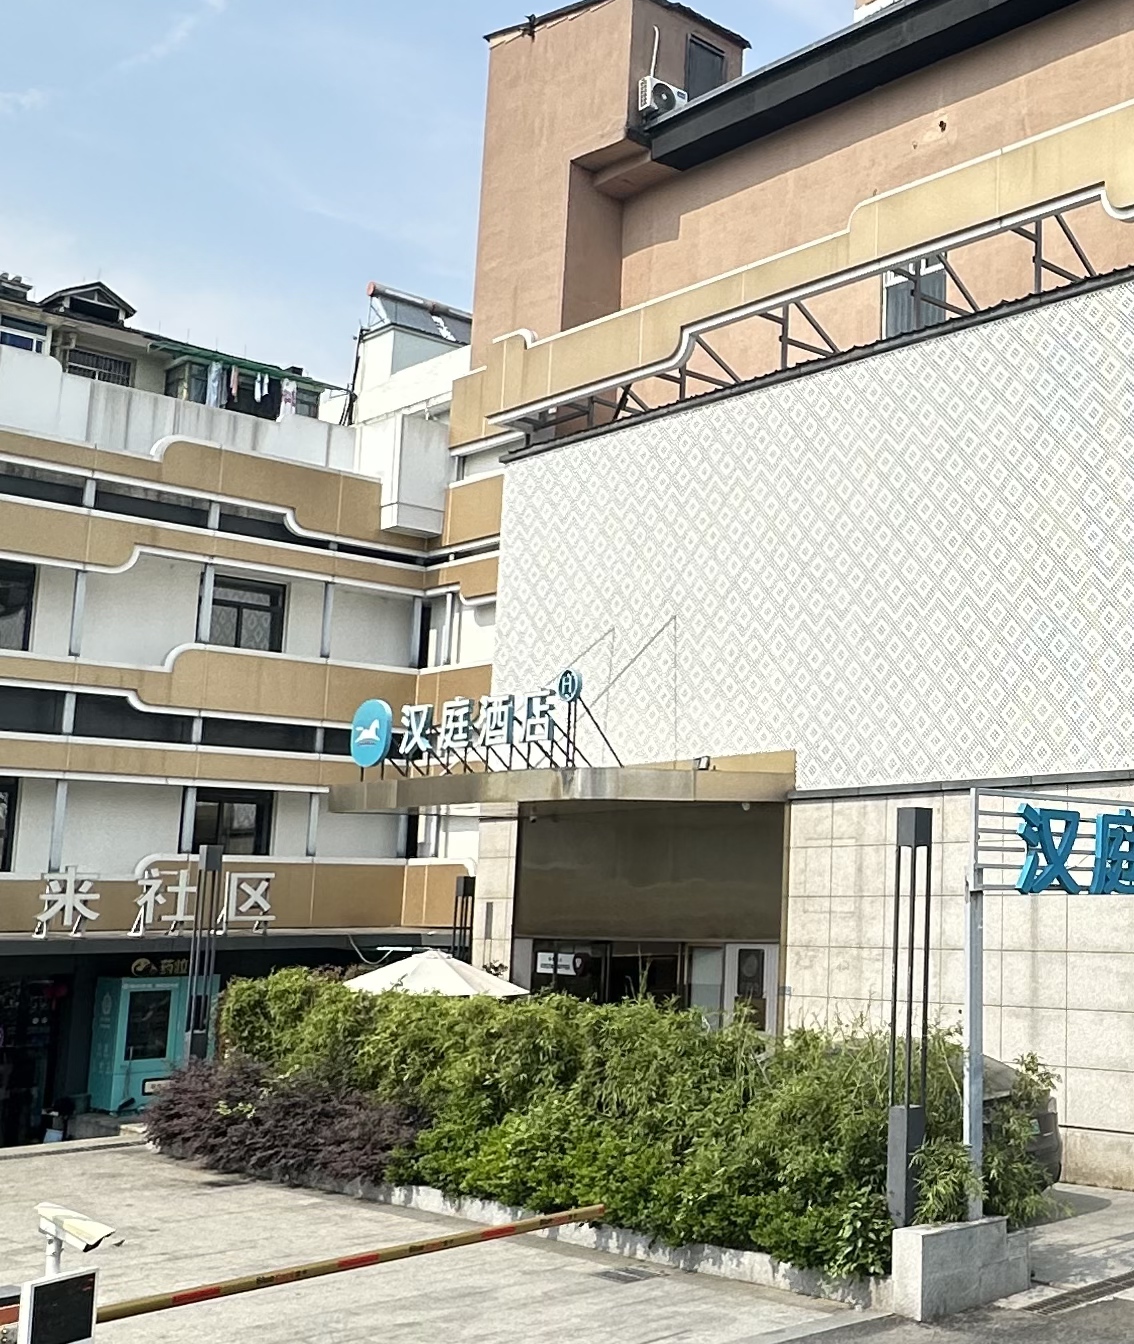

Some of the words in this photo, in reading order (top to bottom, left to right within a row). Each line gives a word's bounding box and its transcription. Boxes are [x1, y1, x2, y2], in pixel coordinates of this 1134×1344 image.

[399, 689, 556, 755] 汉庭酒店
[35, 865, 276, 927] 来社区
